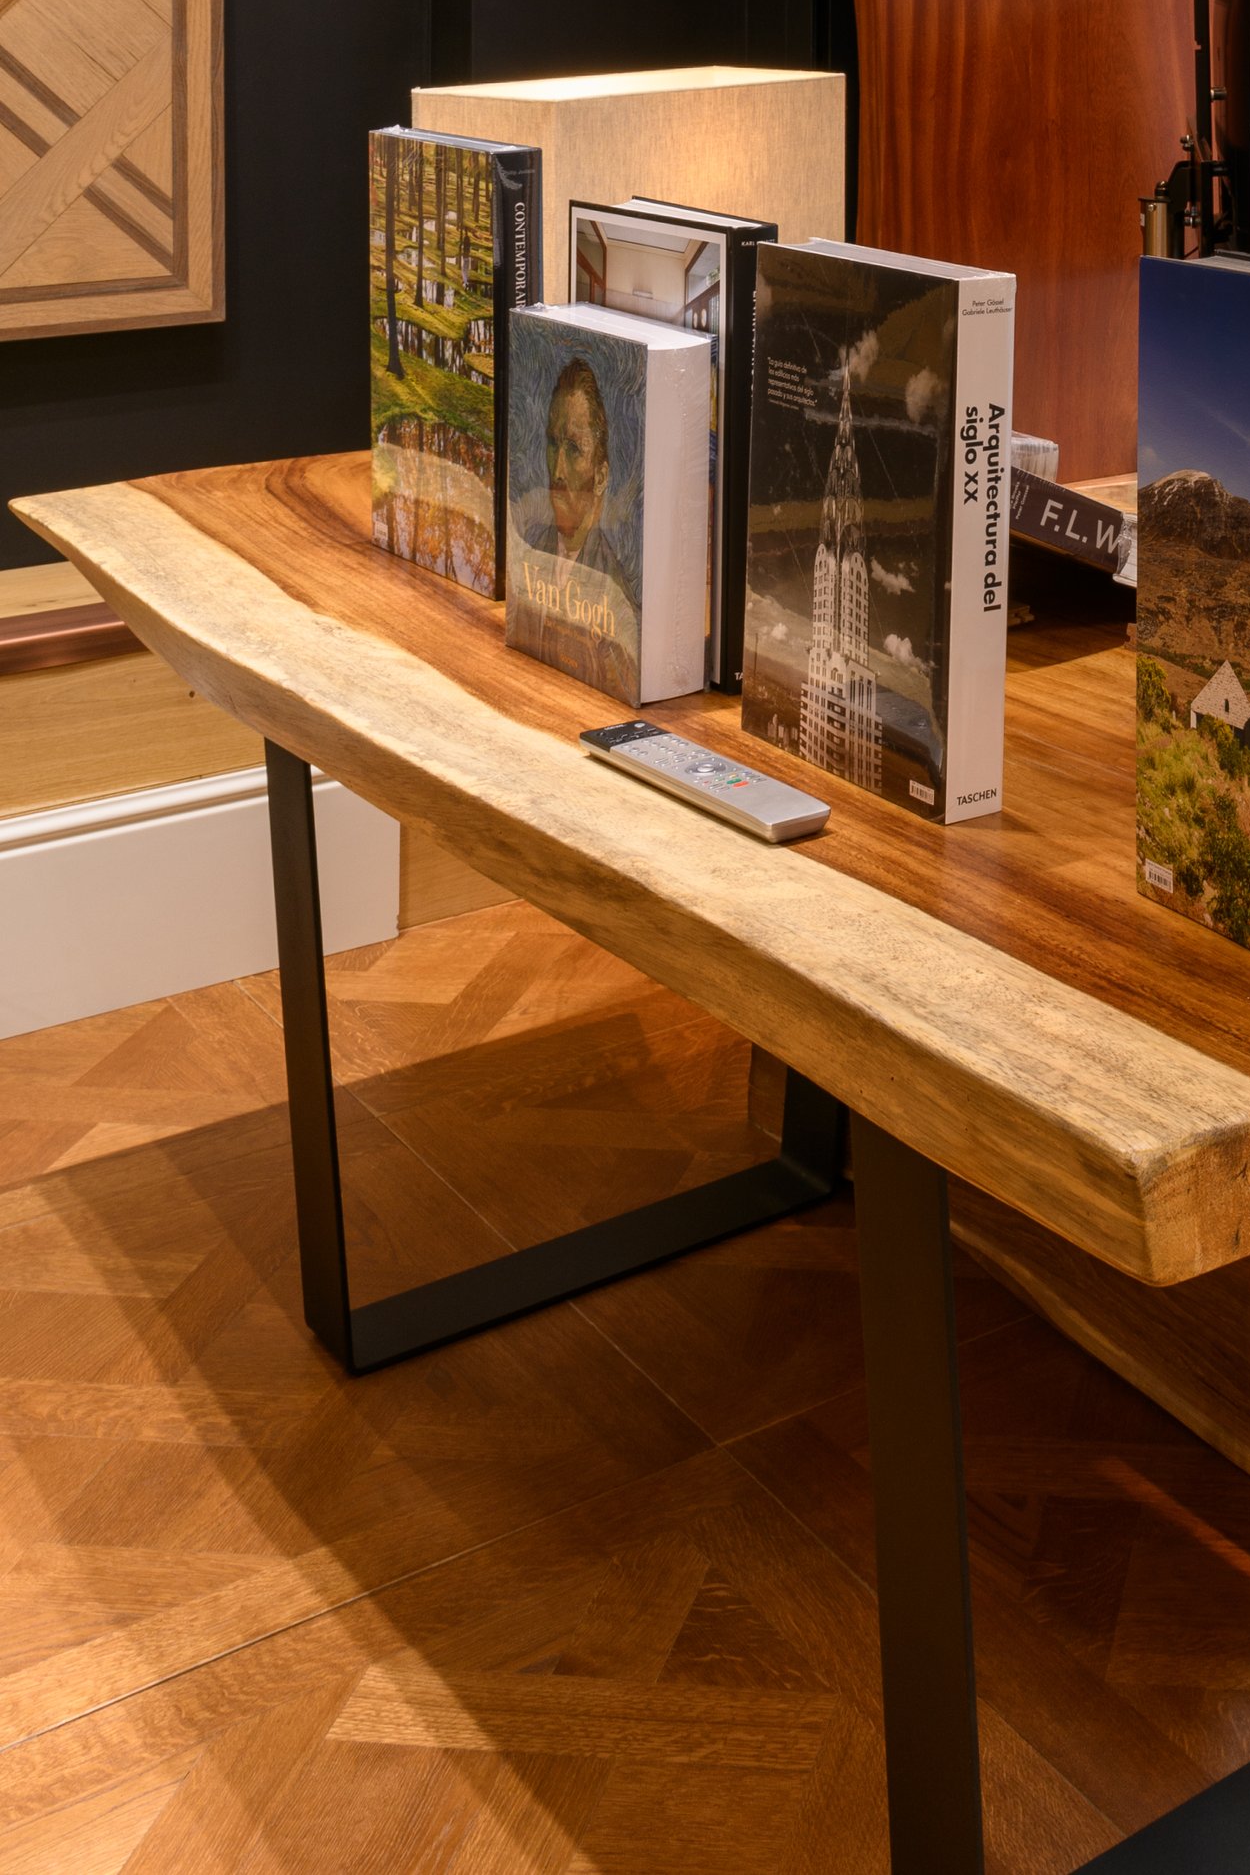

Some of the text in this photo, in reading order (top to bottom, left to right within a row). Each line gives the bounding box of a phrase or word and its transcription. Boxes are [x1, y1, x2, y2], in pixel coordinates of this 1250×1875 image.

[961, 308, 985, 316] Gabriele
[960, 406, 984, 506] siglo XX
[983, 403, 1006, 612] Arquitectura del
[523, 561, 560, 611] Van
[565, 579, 616, 645] Gogh
[957, 788, 997, 806] TASCHEN
